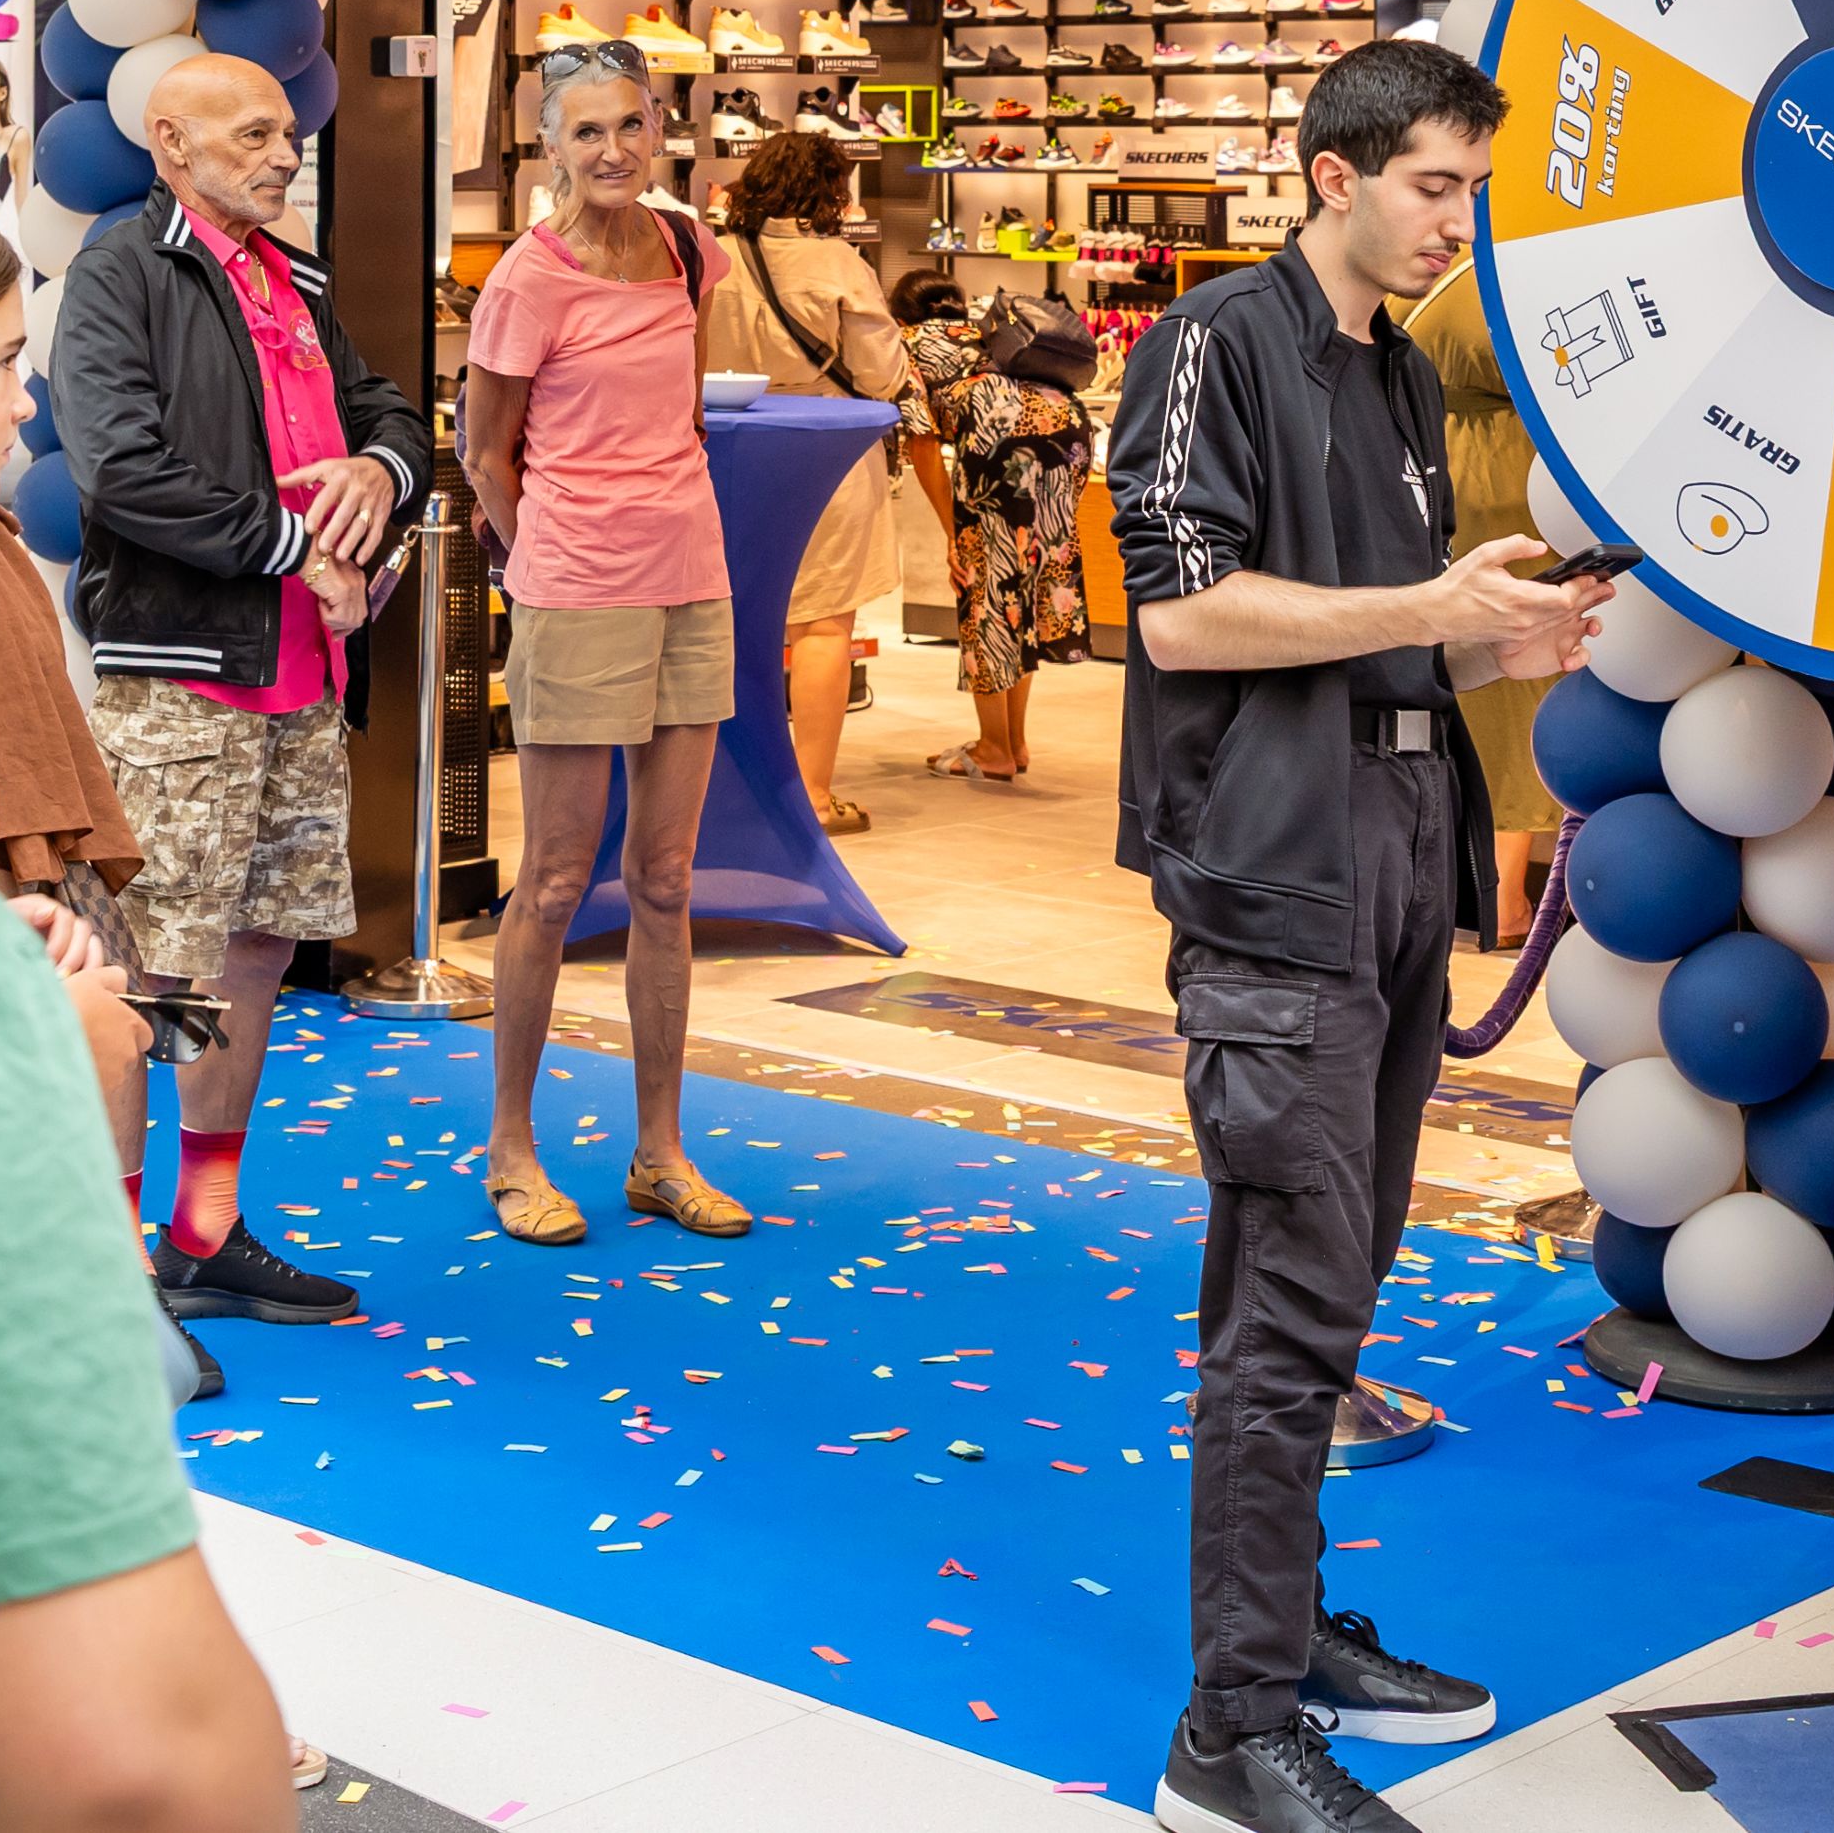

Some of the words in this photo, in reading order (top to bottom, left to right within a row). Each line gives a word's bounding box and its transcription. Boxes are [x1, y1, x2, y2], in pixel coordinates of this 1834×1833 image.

[1546, 33, 1601, 210] 20%
[1596, 67, 1631, 198] korting
[1124, 151, 1209, 165] SKECHERS
[1627, 276, 1667, 339] GIFT
[1703, 404, 1800, 475] GRATIS
